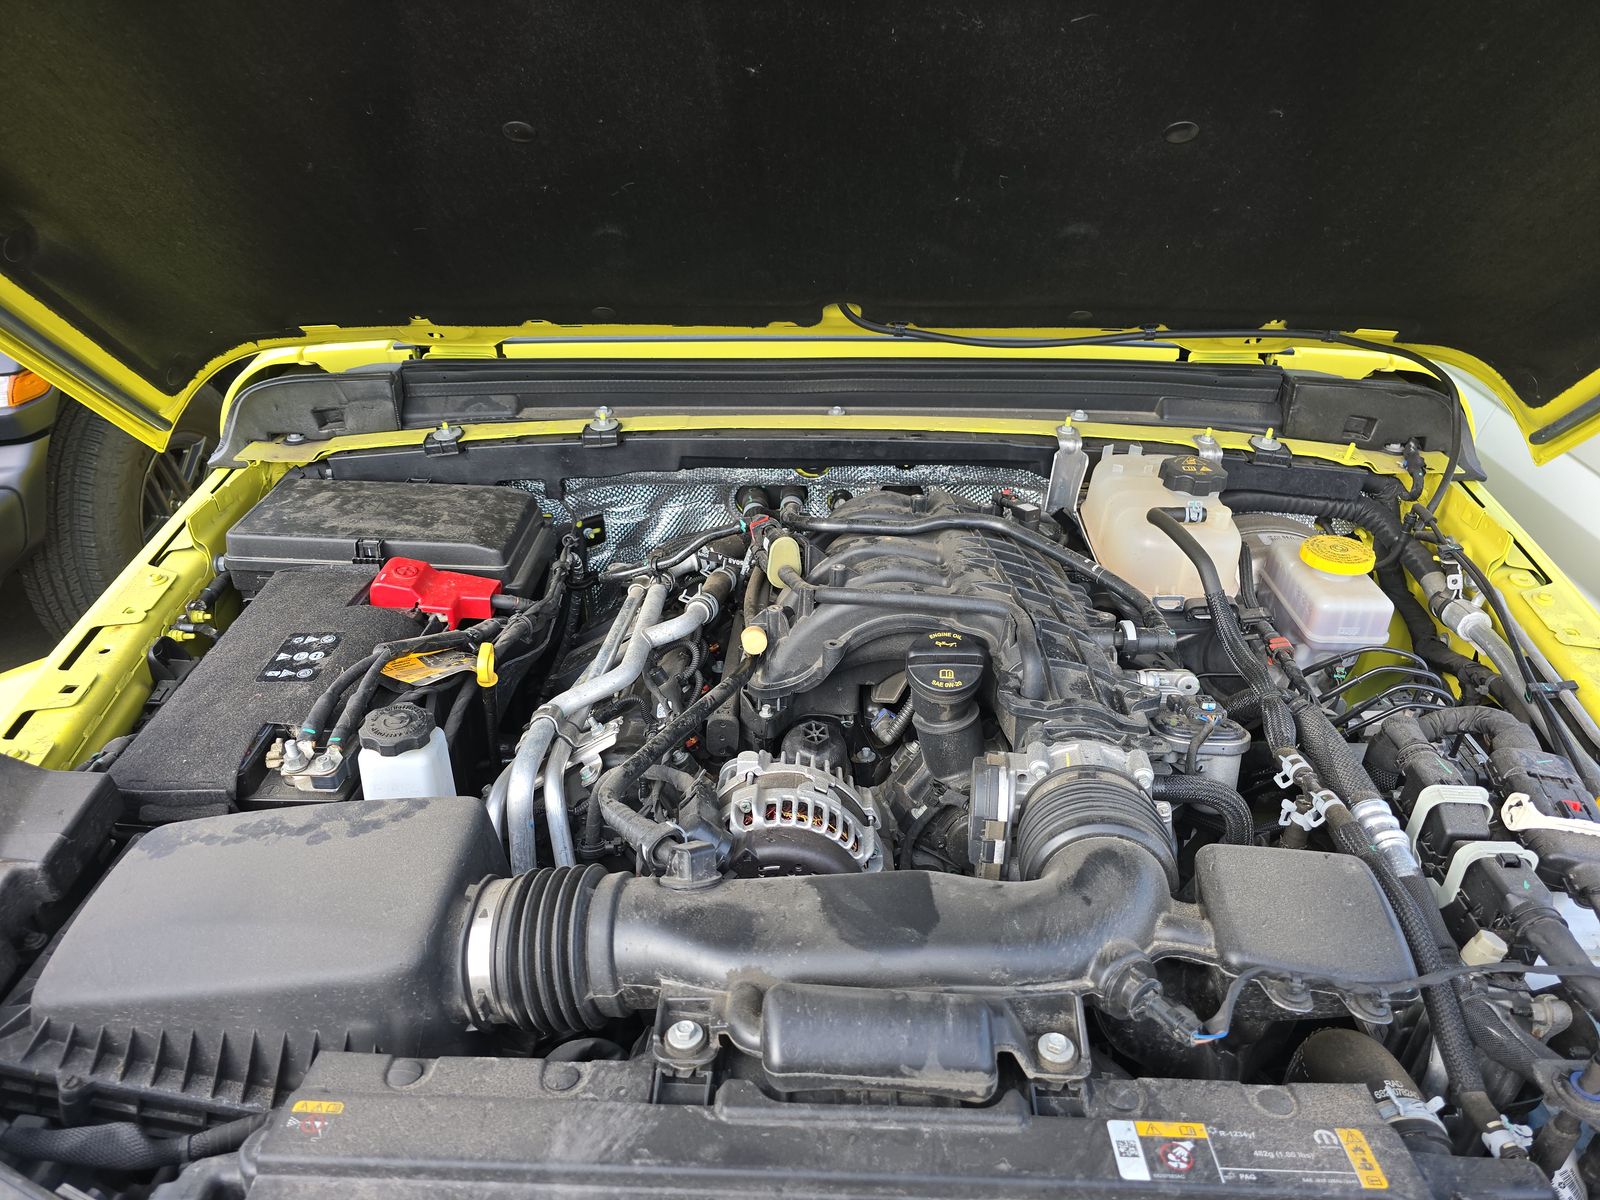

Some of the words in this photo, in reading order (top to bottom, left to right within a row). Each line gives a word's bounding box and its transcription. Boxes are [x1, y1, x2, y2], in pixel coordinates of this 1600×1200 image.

[928, 632, 952, 640] ENGINE
[952, 633, 962, 641] OIL
[931, 680, 944, 688] SAE
[1383, 1079, 1404, 1088] RAD
